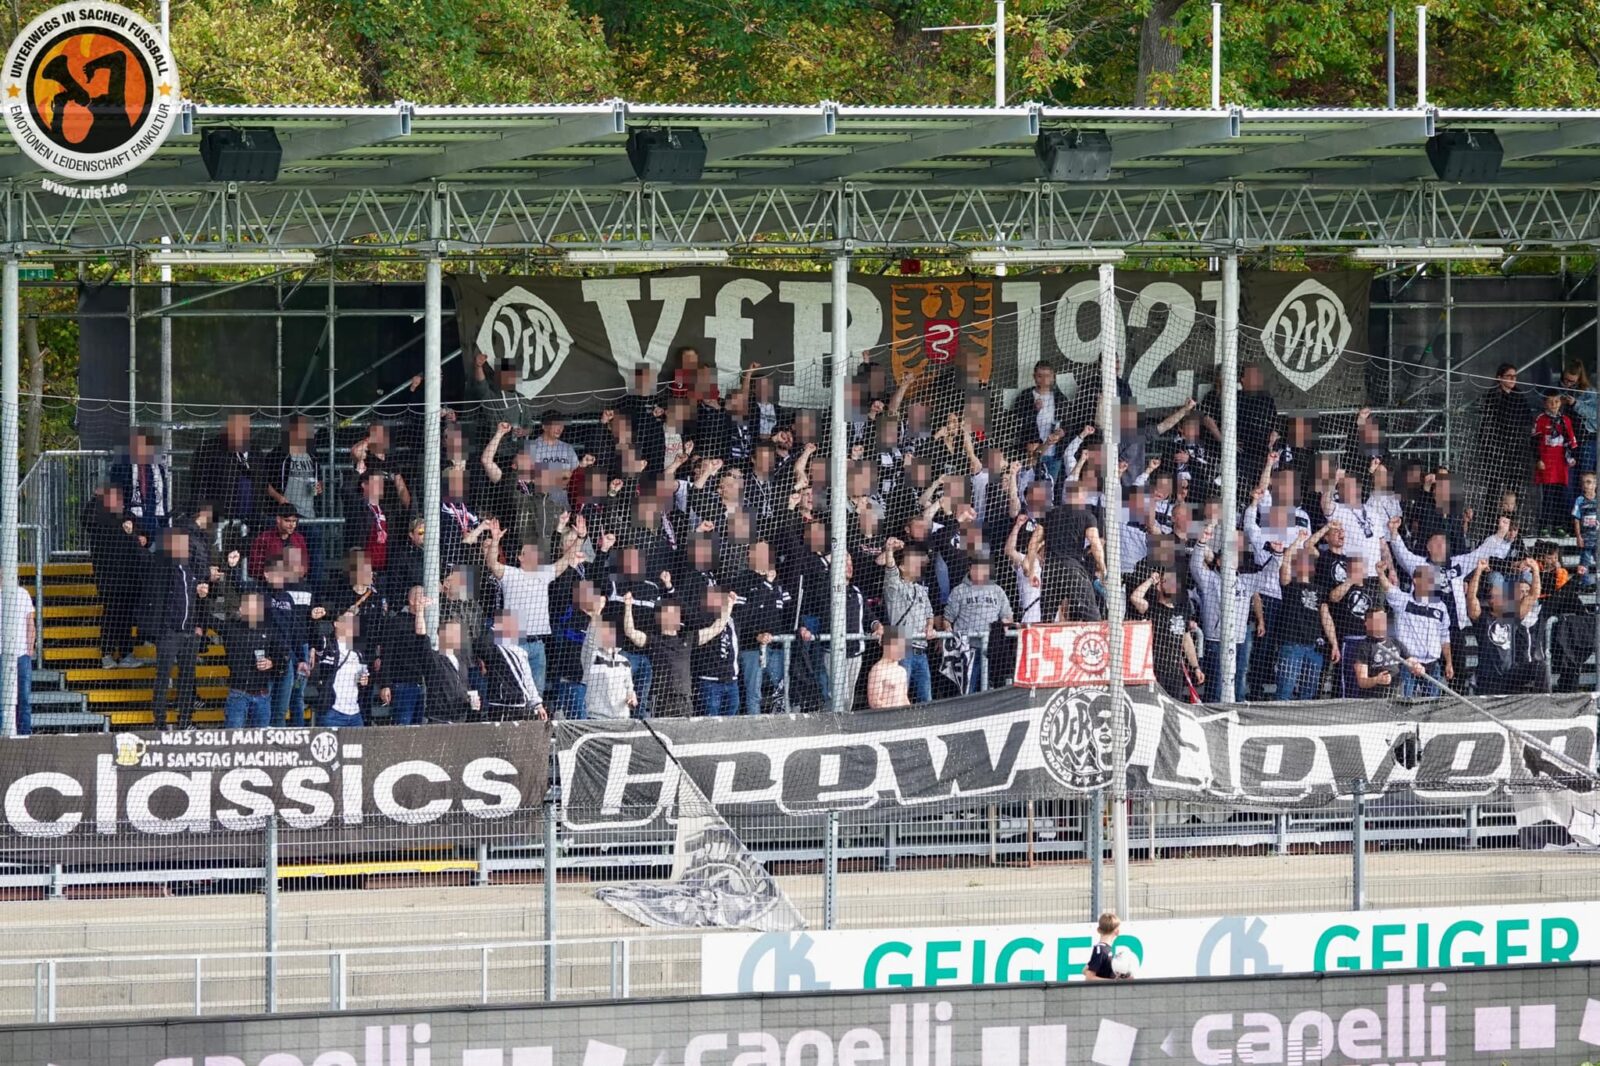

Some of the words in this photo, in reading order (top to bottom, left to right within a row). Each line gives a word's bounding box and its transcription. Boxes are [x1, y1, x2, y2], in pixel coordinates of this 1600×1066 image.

[581, 276, 883, 409] VfR
[1002, 279, 1241, 410] 1921
[1278, 298, 1335, 371] VfR
[141, 752, 164, 767] AM
[167, 751, 231, 768] SAMSTAG
[195, 731, 229, 746] SOLL
[231, 730, 263, 745] MAN
[266, 730, 311, 745] SONST
[3, 743, 522, 838] classics
[1313, 916, 1580, 972] GEIGER
[1191, 982, 1447, 1066] capelli
